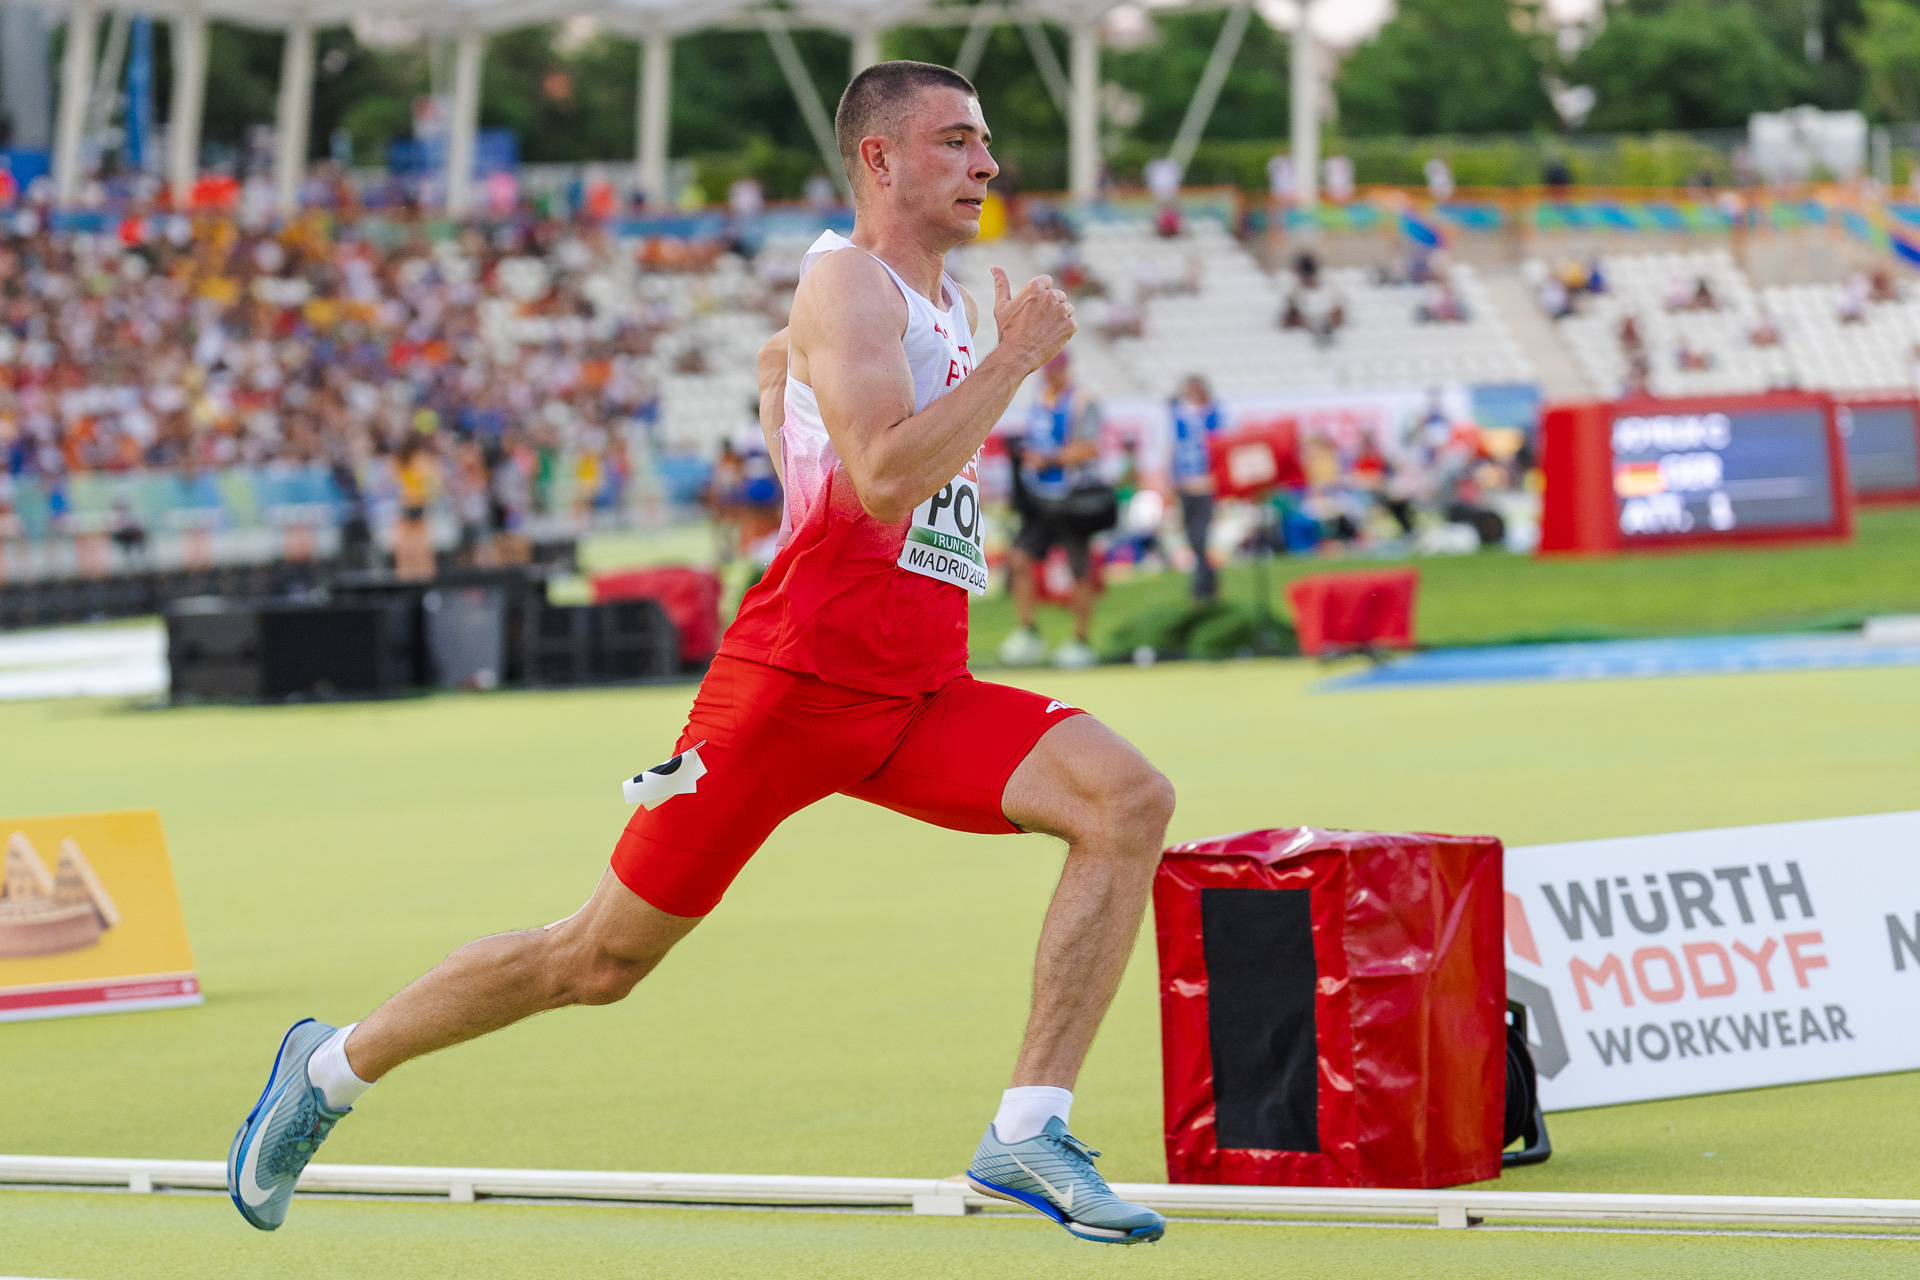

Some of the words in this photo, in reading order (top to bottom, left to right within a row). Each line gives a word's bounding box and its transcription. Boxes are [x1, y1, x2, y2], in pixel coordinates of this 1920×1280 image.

[927, 482, 981, 547] POL
[938, 534, 960, 552] RUN
[908, 547, 969, 580] MADRID
[969, 566, 987, 590] 2025
[1568, 931, 1829, 1012] MODYF
[1587, 1005, 1854, 1067] WORKWEAR
